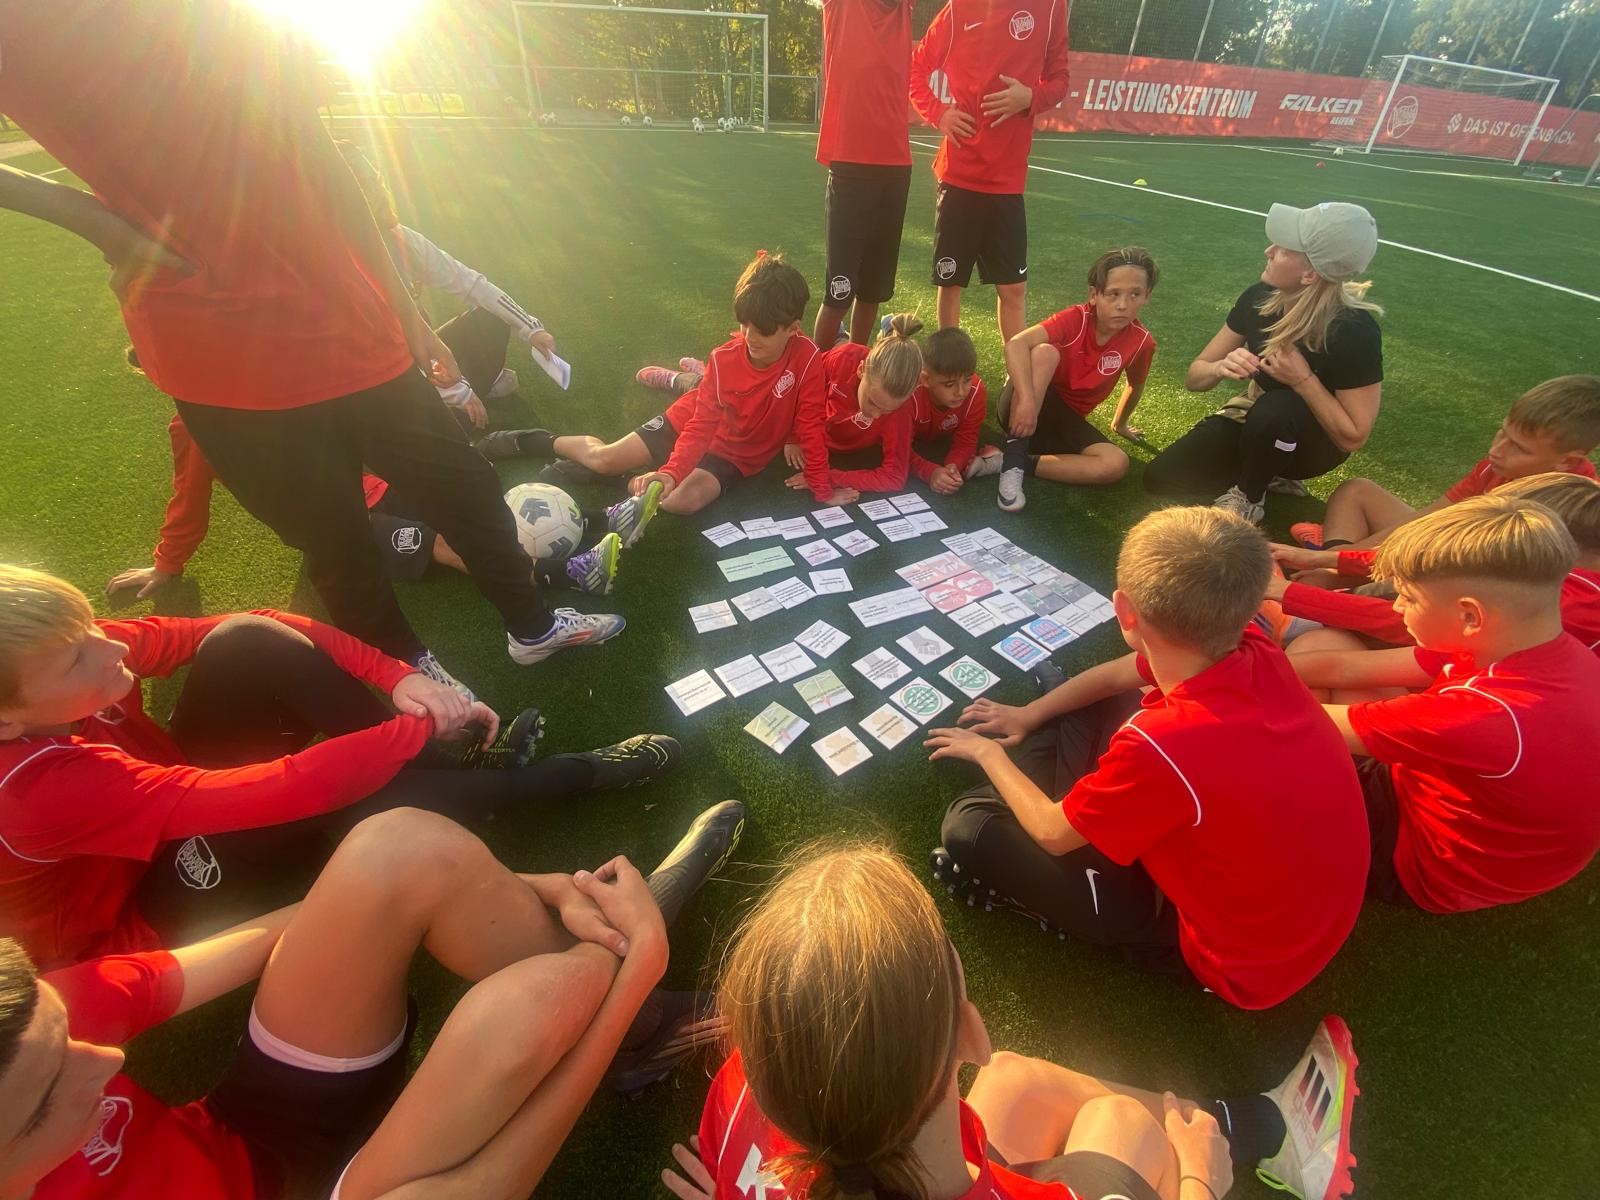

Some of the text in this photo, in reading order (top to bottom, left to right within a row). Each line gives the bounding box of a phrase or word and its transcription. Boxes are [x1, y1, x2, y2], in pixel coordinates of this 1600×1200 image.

[1083, 79, 1258, 119] LEISTUNGSZENTRUM
[1279, 93, 1363, 115] FALKEN
[1463, 117, 1489, 134] DAS
[1489, 120, 1511, 136] IST
[1510, 123, 1575, 145] OFENBACH
